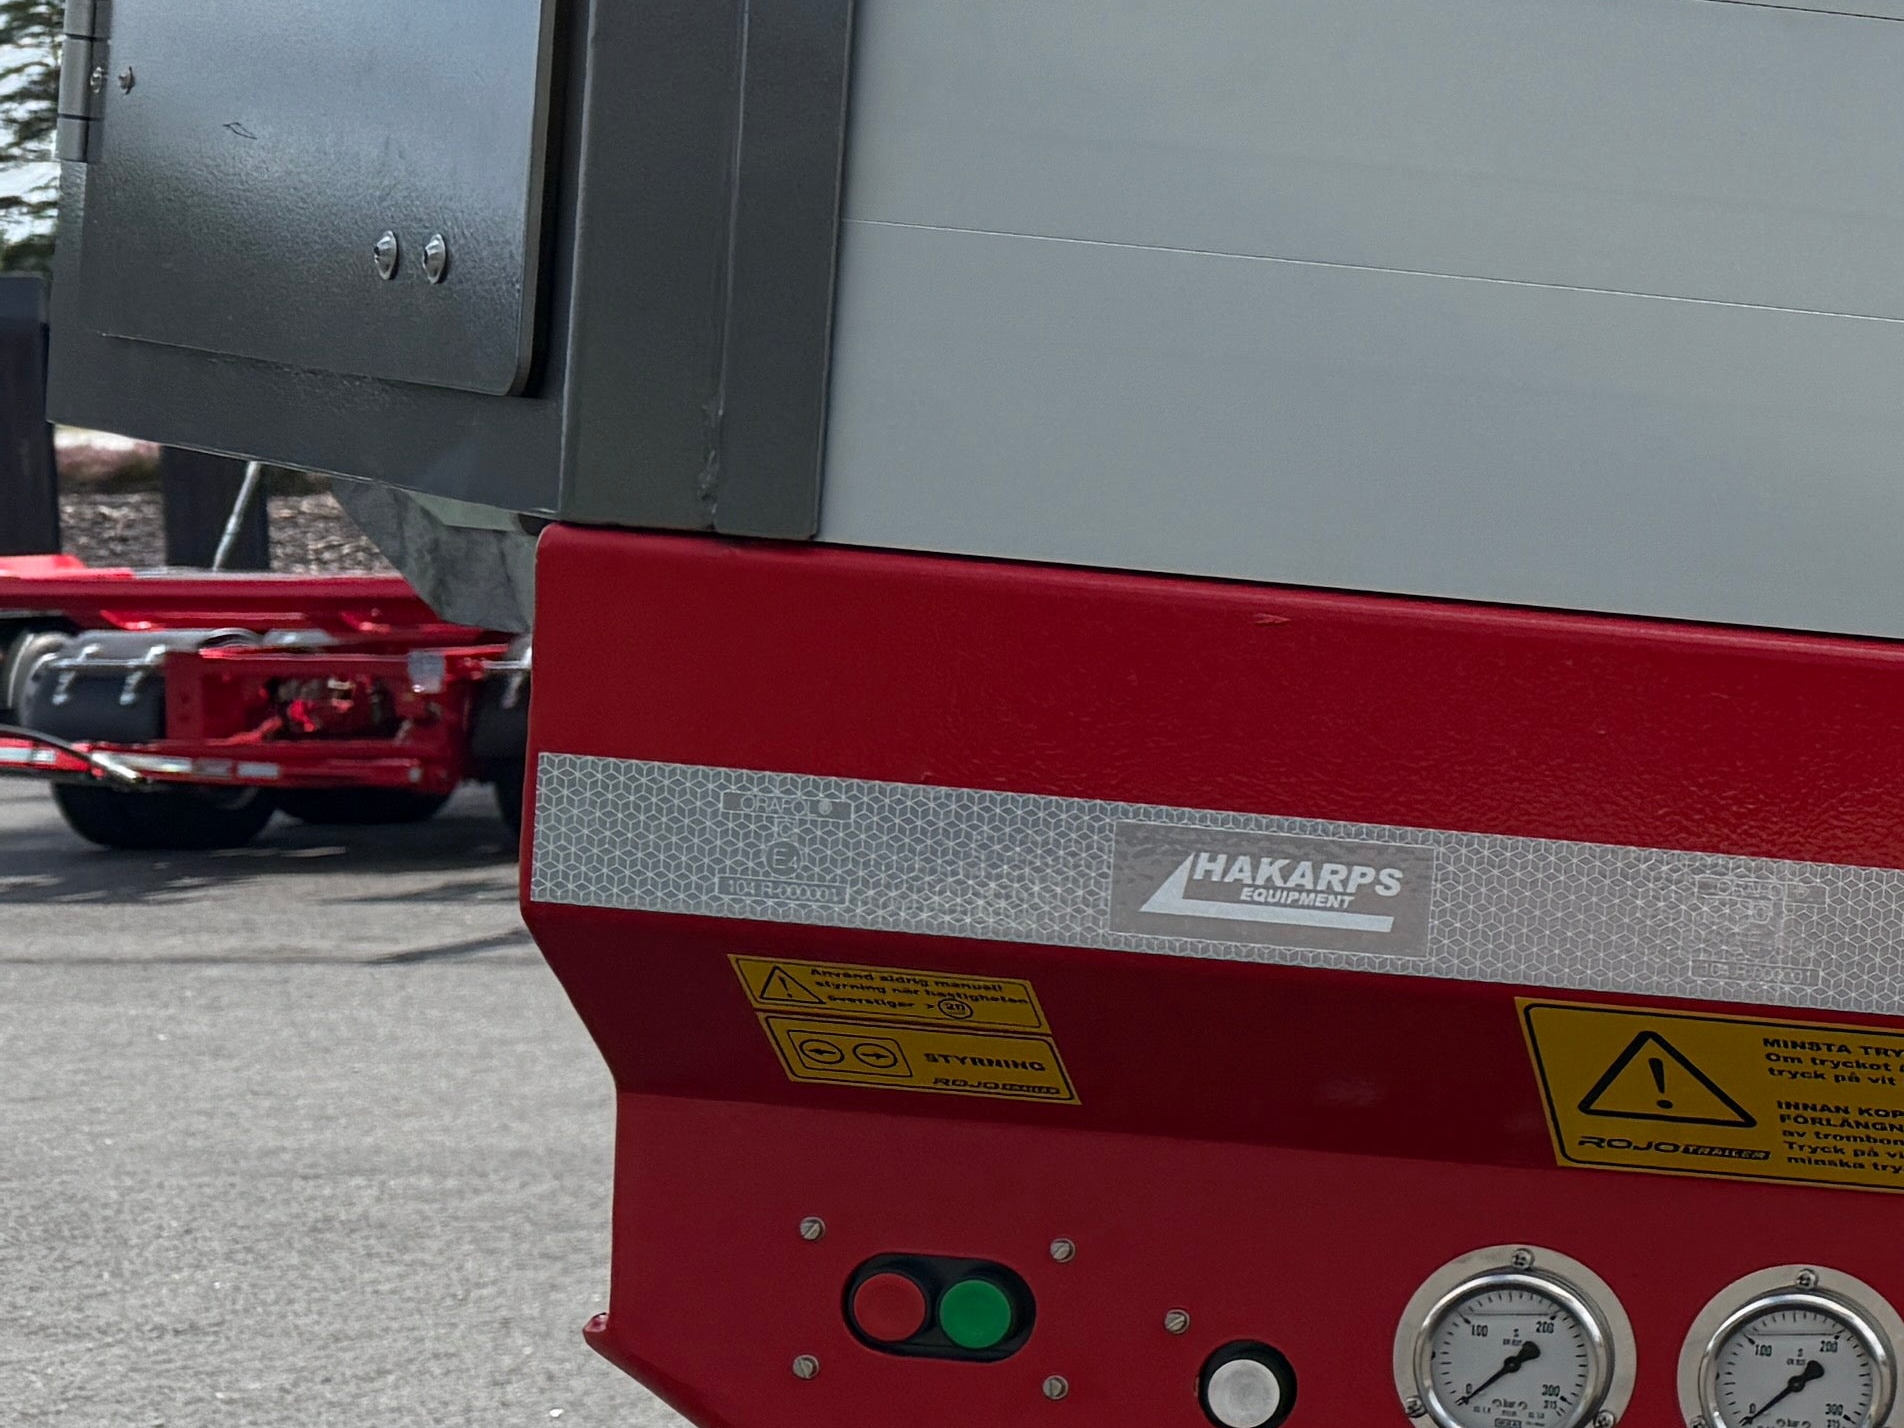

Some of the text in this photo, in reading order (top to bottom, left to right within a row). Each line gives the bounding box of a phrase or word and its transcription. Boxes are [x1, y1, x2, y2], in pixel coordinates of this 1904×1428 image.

[1193, 851, 1404, 897] HAKARPS
[1239, 886, 1354, 910] EQUIPMENT
[1763, 1037, 1852, 1054] MINSTA
[923, 1052, 1047, 1072] STYRNING
[1765, 1052, 1803, 1064] Om
[1768, 1066, 1826, 1080] tryck
[1776, 1099, 1850, 1115] INNAN
[1577, 1135, 1681, 1154] ROJO
[1783, 1139, 1846, 1156] Tryck
